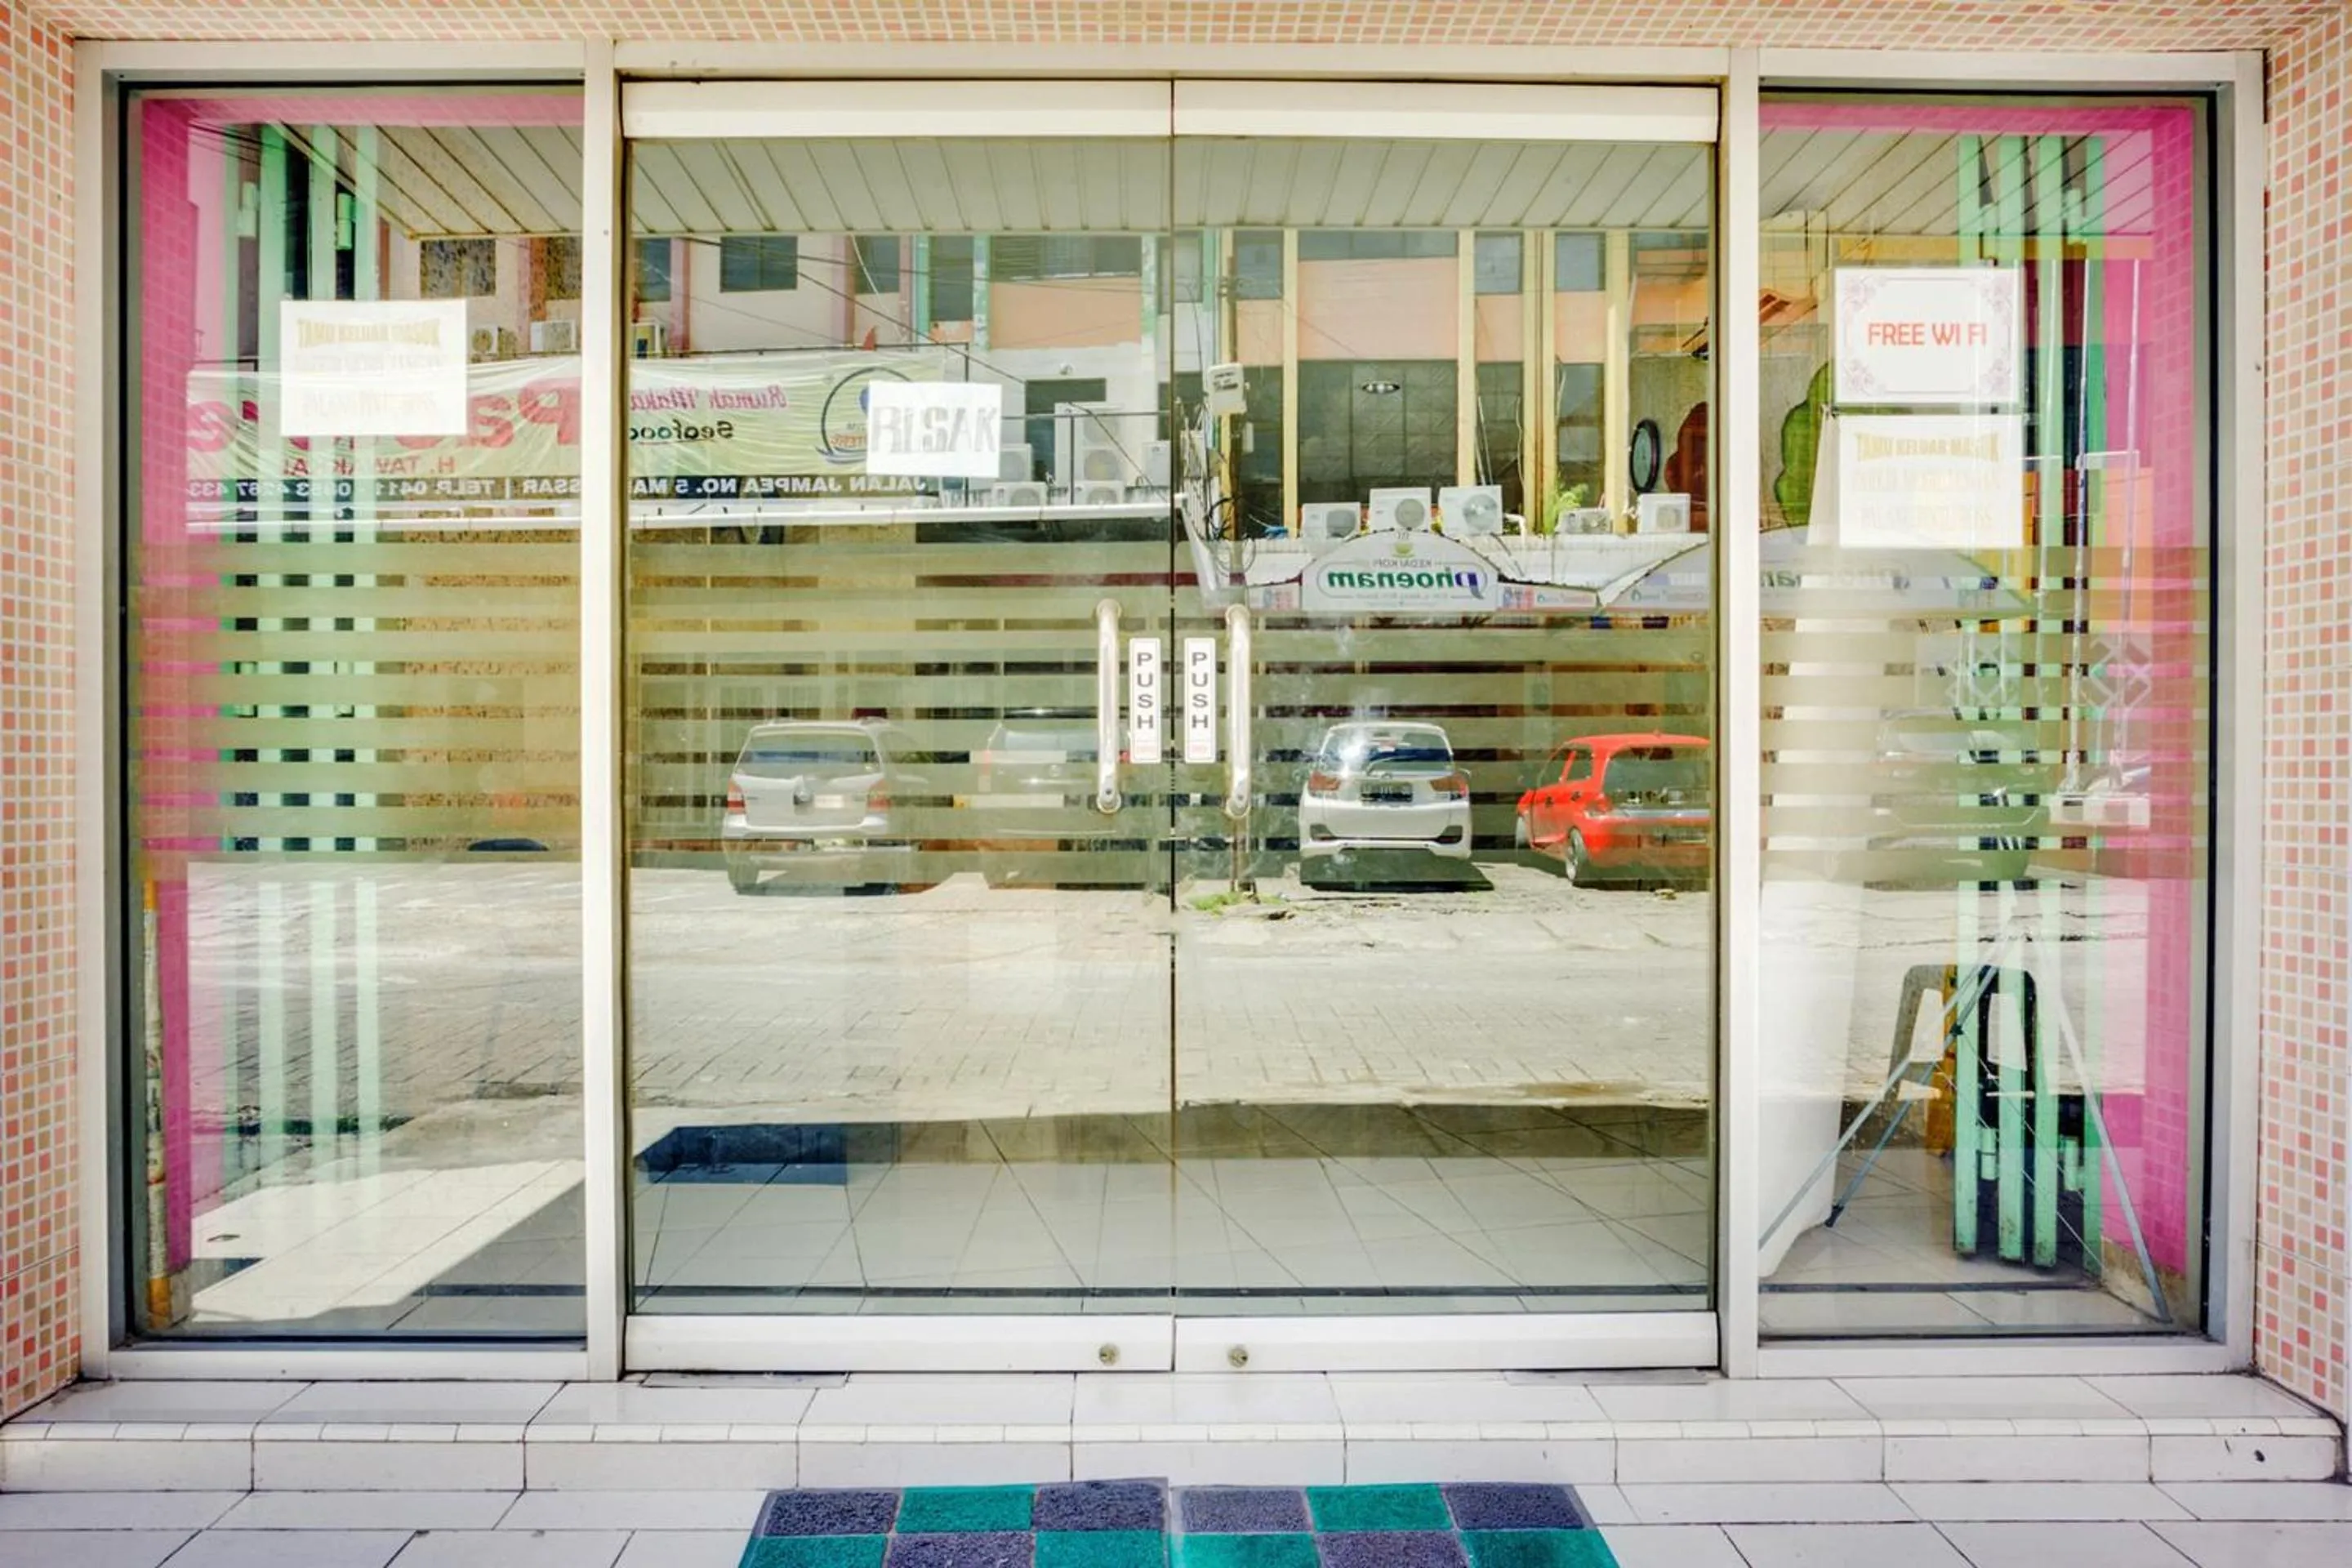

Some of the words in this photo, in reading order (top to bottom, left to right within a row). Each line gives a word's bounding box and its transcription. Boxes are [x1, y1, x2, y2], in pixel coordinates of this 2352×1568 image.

[1868, 323, 1926, 345] FREE
[1931, 323, 1960, 345] WI
[1968, 323, 1987, 345] FI
[1136, 652, 1153, 728] PUSH
[1192, 652, 1209, 728] PUSH
